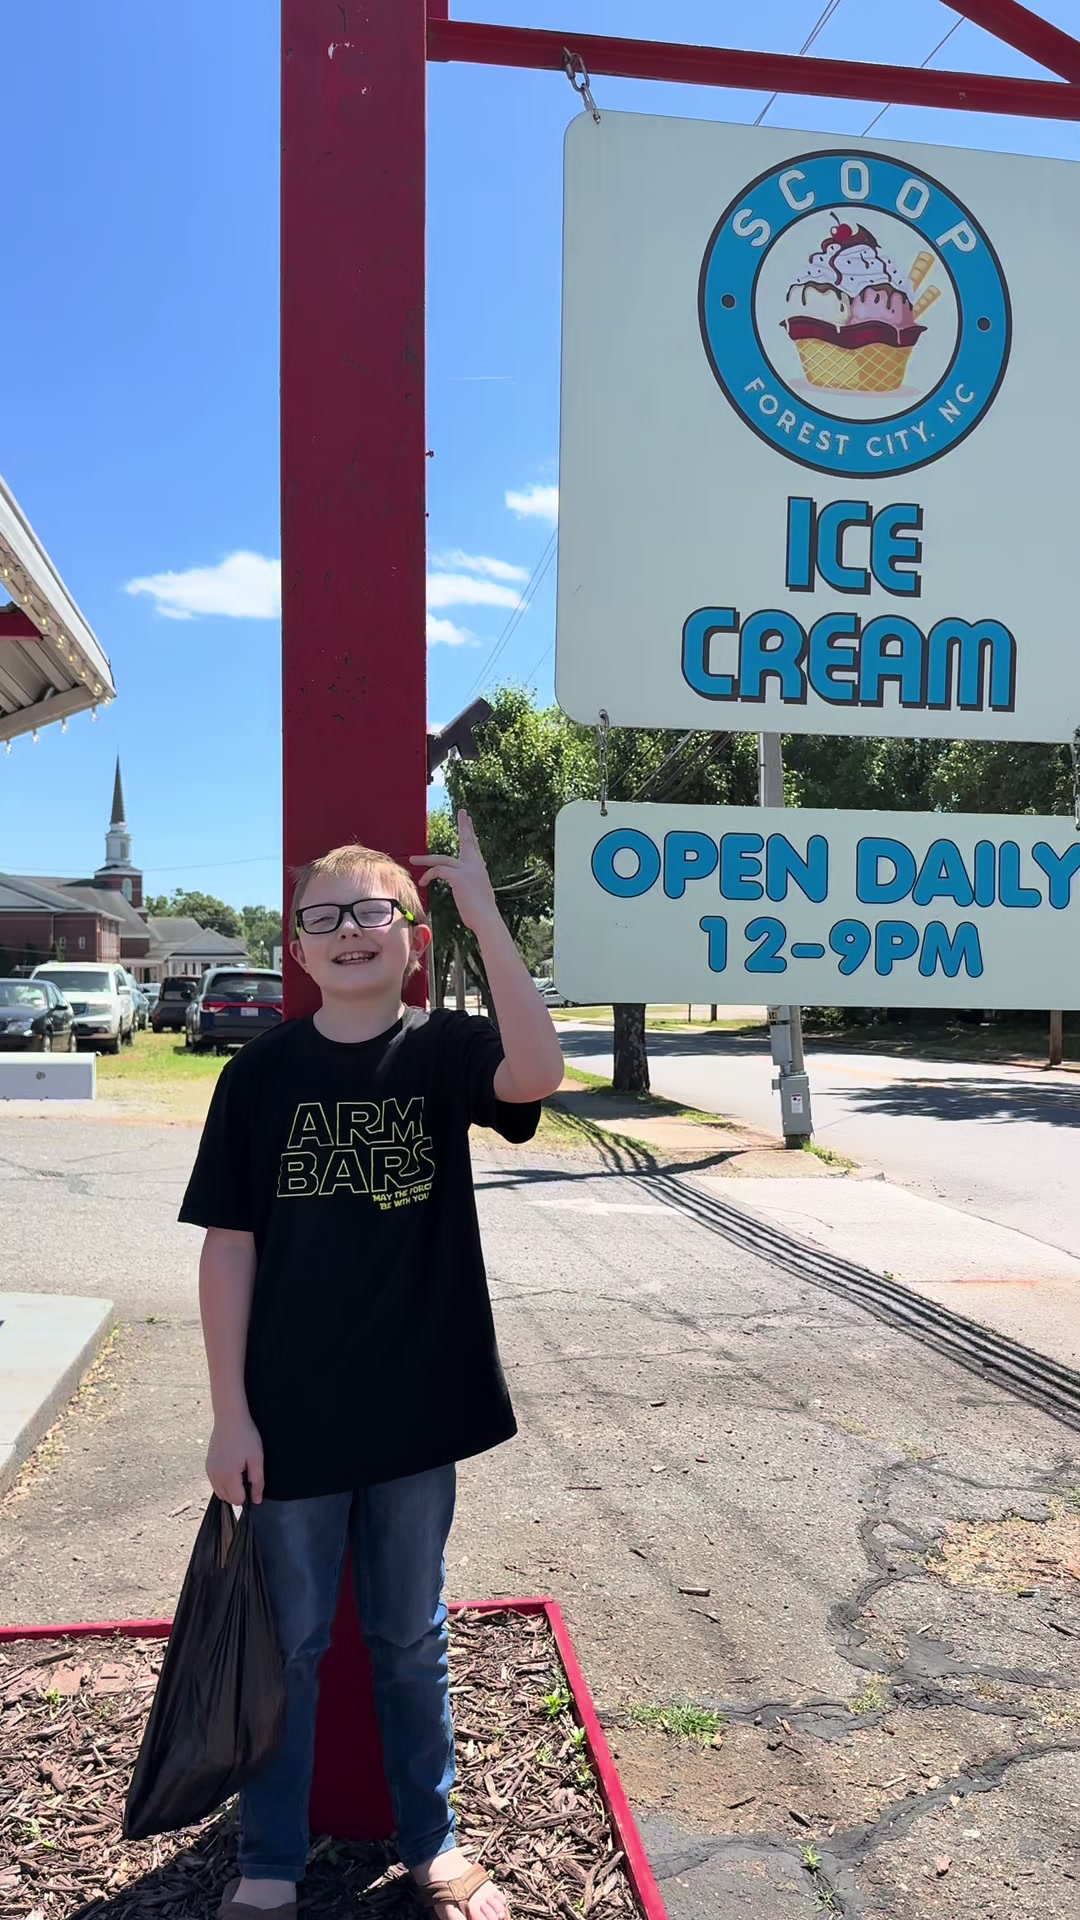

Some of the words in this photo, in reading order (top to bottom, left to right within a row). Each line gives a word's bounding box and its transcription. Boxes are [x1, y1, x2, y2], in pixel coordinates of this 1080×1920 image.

[731, 159, 977, 253] SCOOP
[743, 376, 850, 456] FOREST
[938, 383, 975, 425] NC
[785, 496, 923, 598] ICE
[681, 606, 1017, 712] CREAM
[591, 828, 829, 903] OPEN
[856, 837, 1080, 910] DAILY
[699, 915, 984, 978] 12-9PM
[287, 1097, 425, 1148] ARM
[277, 1136, 435, 1197] BARS
[372, 1193, 393, 1202] MAY
[394, 1189, 408, 1198] THE
[379, 1202, 392, 1210] BE
[393, 1197, 411, 1207] WITH
[412, 1192, 430, 1202] YOU
